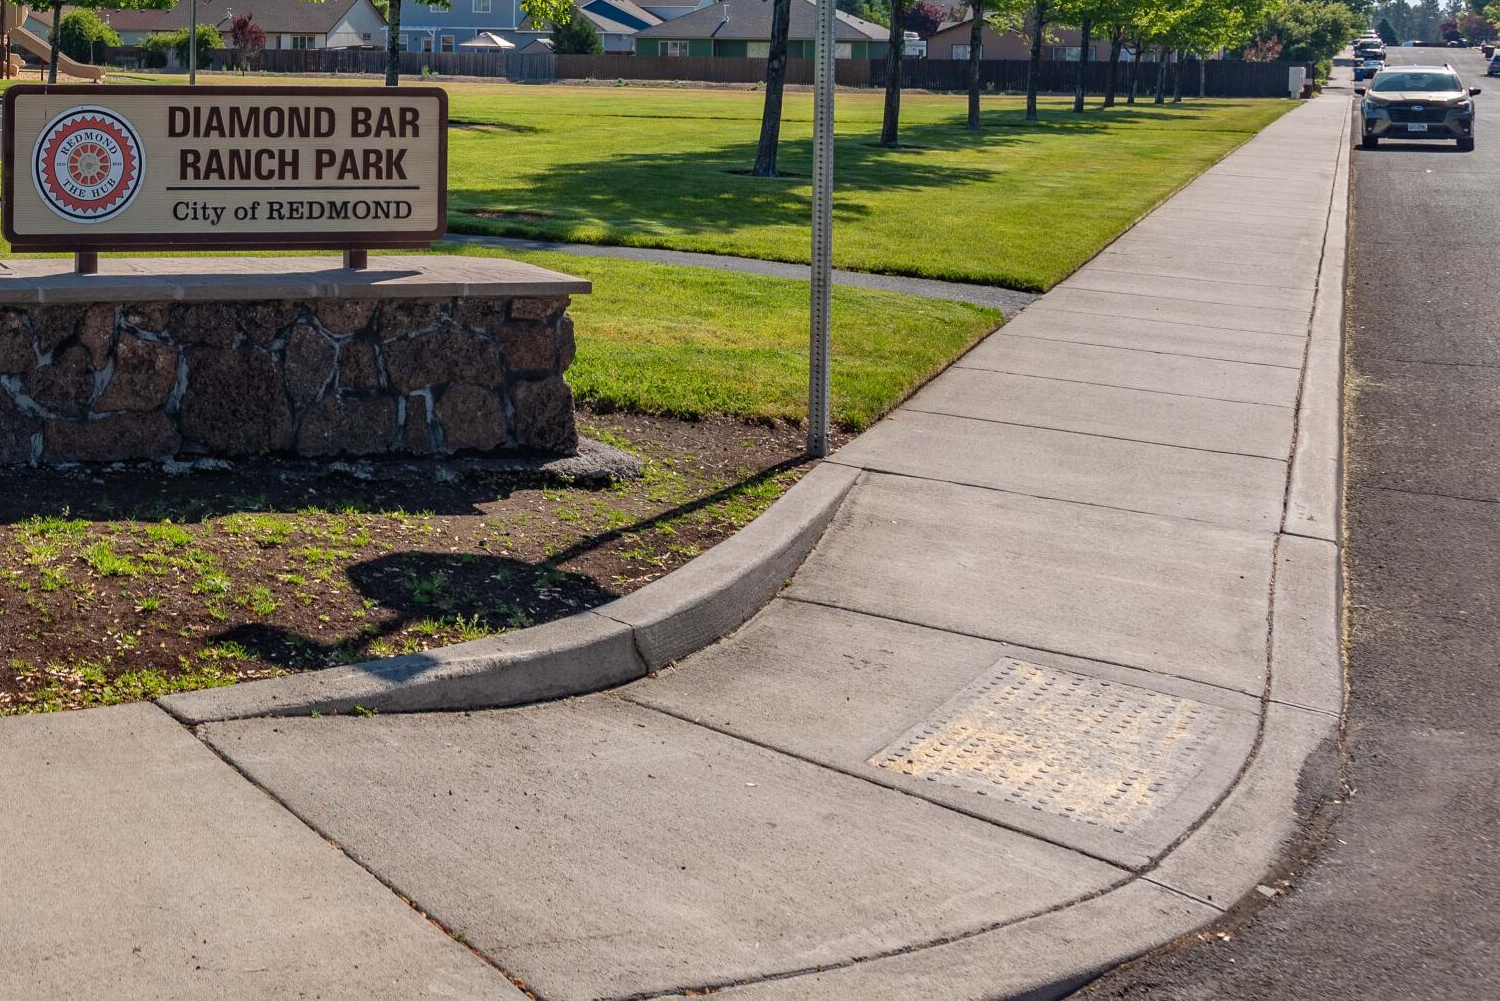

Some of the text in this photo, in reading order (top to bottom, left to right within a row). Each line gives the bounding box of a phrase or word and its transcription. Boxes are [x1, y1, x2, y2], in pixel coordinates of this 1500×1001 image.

[168, 106, 420, 138] DIAMOND BAR
[61, 132, 118, 155] REDMOND
[179, 149, 408, 180] RANCH PARK
[63, 178, 116, 198] THE HUB
[172, 200, 412, 225] City of REDMOND
